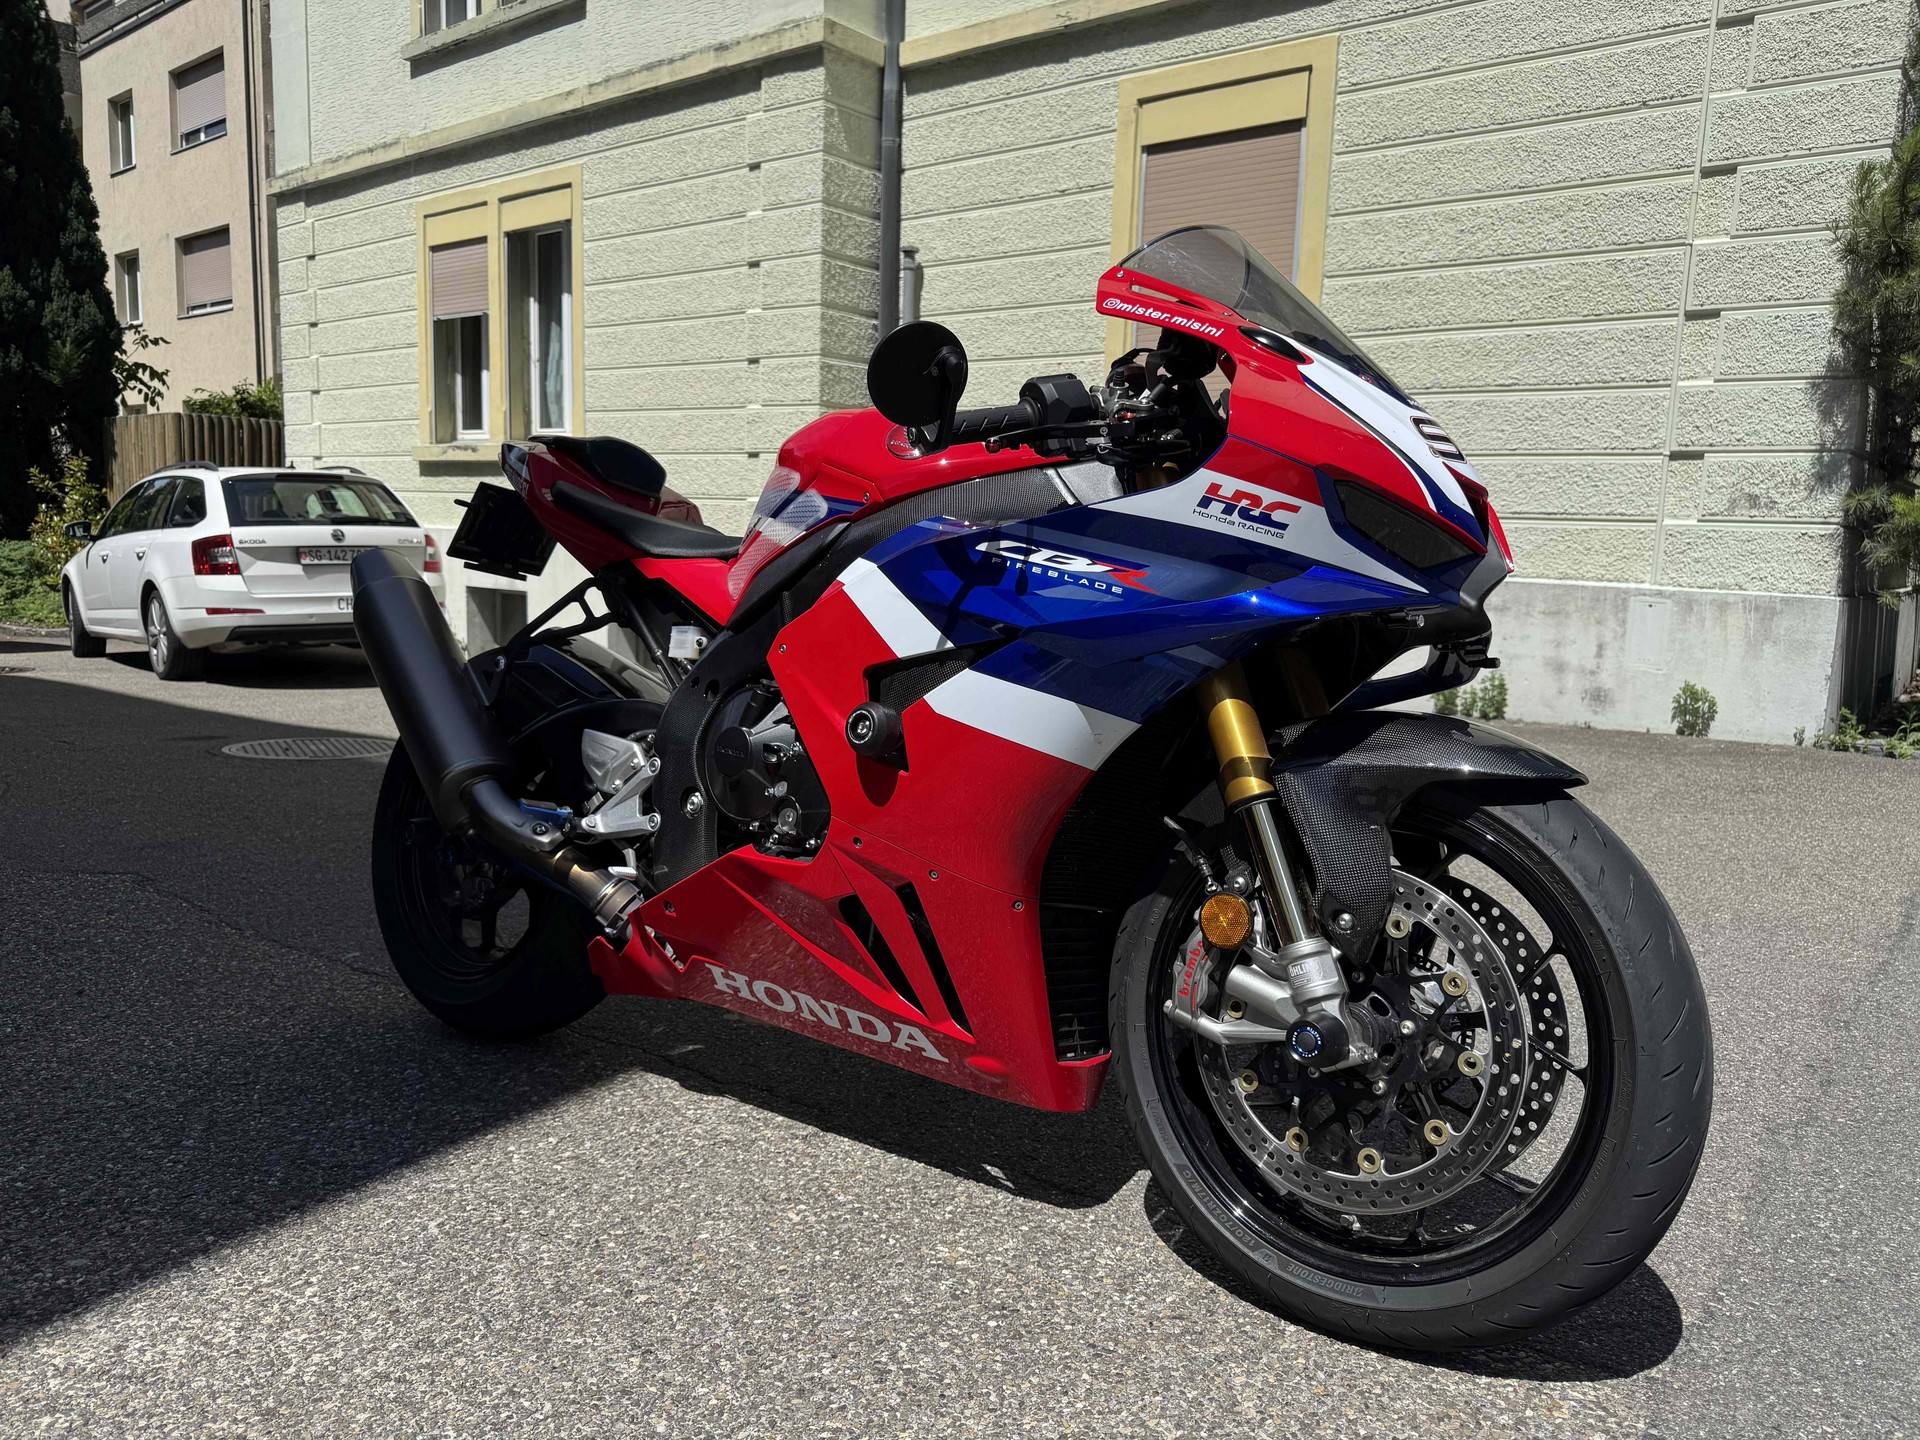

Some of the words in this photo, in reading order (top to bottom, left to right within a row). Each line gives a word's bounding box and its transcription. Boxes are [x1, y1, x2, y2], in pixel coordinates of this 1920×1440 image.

[1192, 508, 1236, 527] Honda
[1237, 521, 1285, 540] RACING
[1196, 481, 1303, 532] HRC
[991, 557, 1124, 594] FIREBLADE
[337, 598, 353, 611] CH
[704, 962, 950, 1063] HONDA
[1286, 1263, 1365, 1298] BRIDGESTONE
